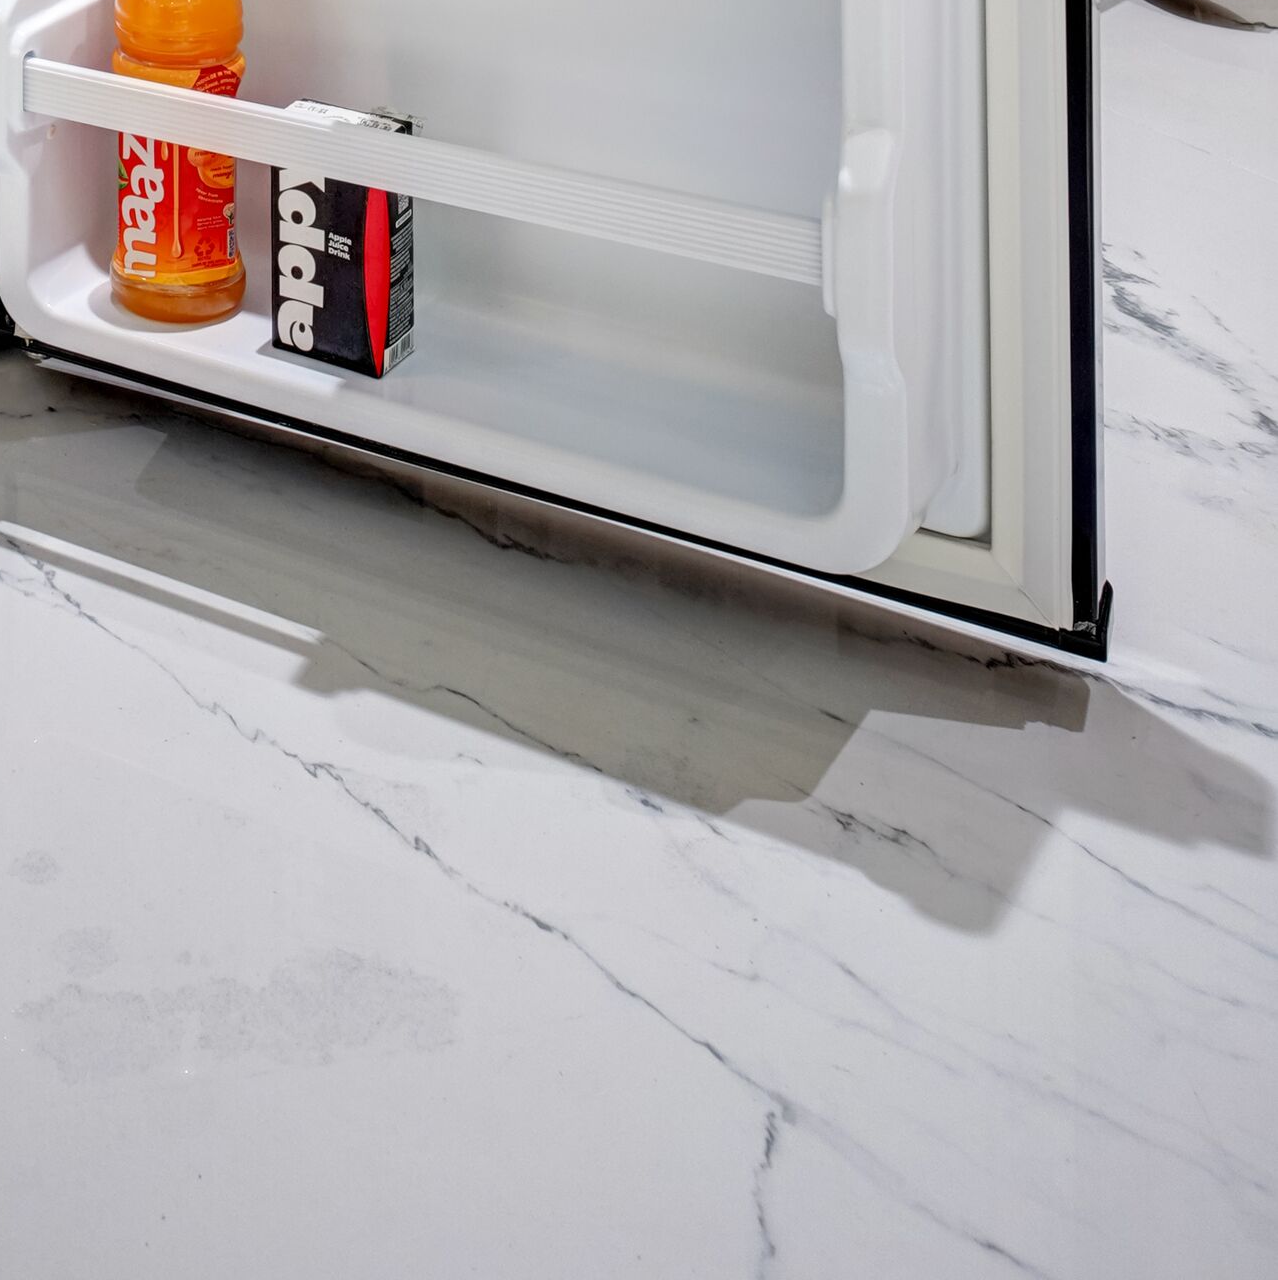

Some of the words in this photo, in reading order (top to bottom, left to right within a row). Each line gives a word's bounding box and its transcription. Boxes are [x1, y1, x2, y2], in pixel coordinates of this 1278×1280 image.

[121, 131, 165, 278] maaz
[328, 231, 352, 246] Apple
[328, 239, 349, 252] Juice
[328, 246, 351, 261] Drink
